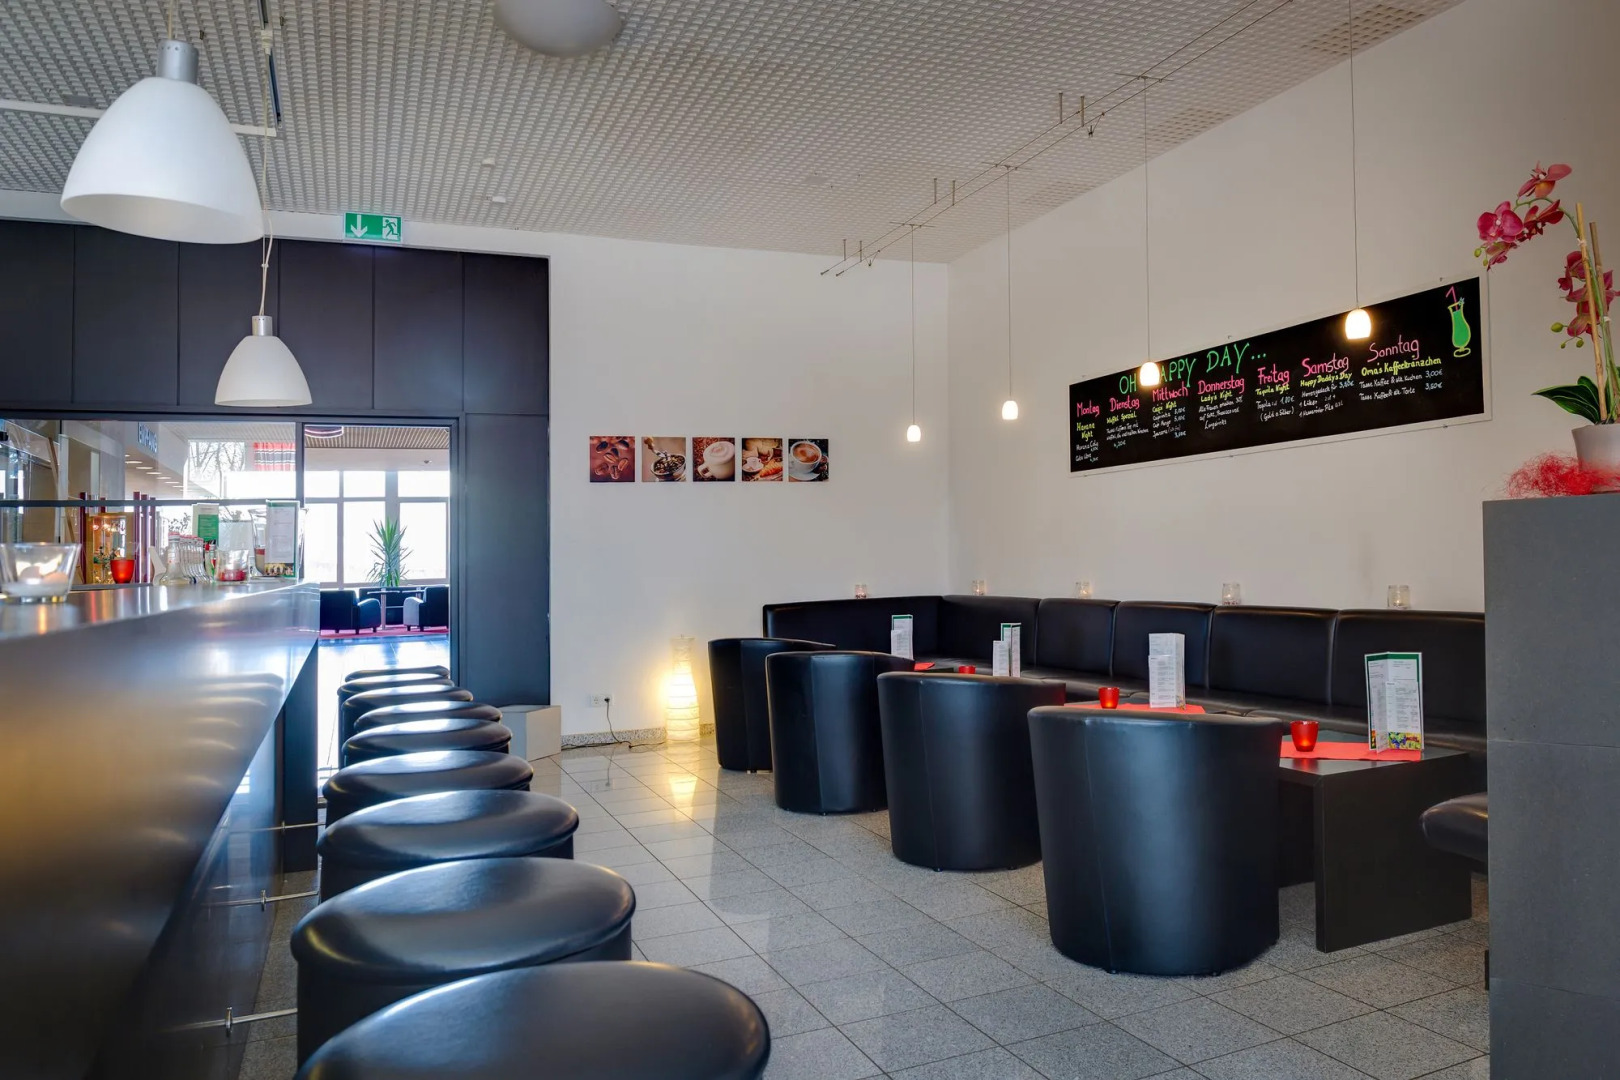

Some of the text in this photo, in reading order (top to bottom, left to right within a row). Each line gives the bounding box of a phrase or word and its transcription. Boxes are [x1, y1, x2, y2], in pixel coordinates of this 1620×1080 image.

[1367, 334, 1420, 362] Sonntag
[1257, 363, 1290, 386] Freitag
[1302, 352, 1349, 377] Samstag
[1119, 372, 1137, 395] OH
[1160, 358, 1197, 388] APPY
[1197, 375, 1245, 395] Donnerstag
[1152, 380, 1189, 402] Mittwoch
[1076, 399, 1100, 418] Montag
[1109, 395, 1140, 413] Dienstag
